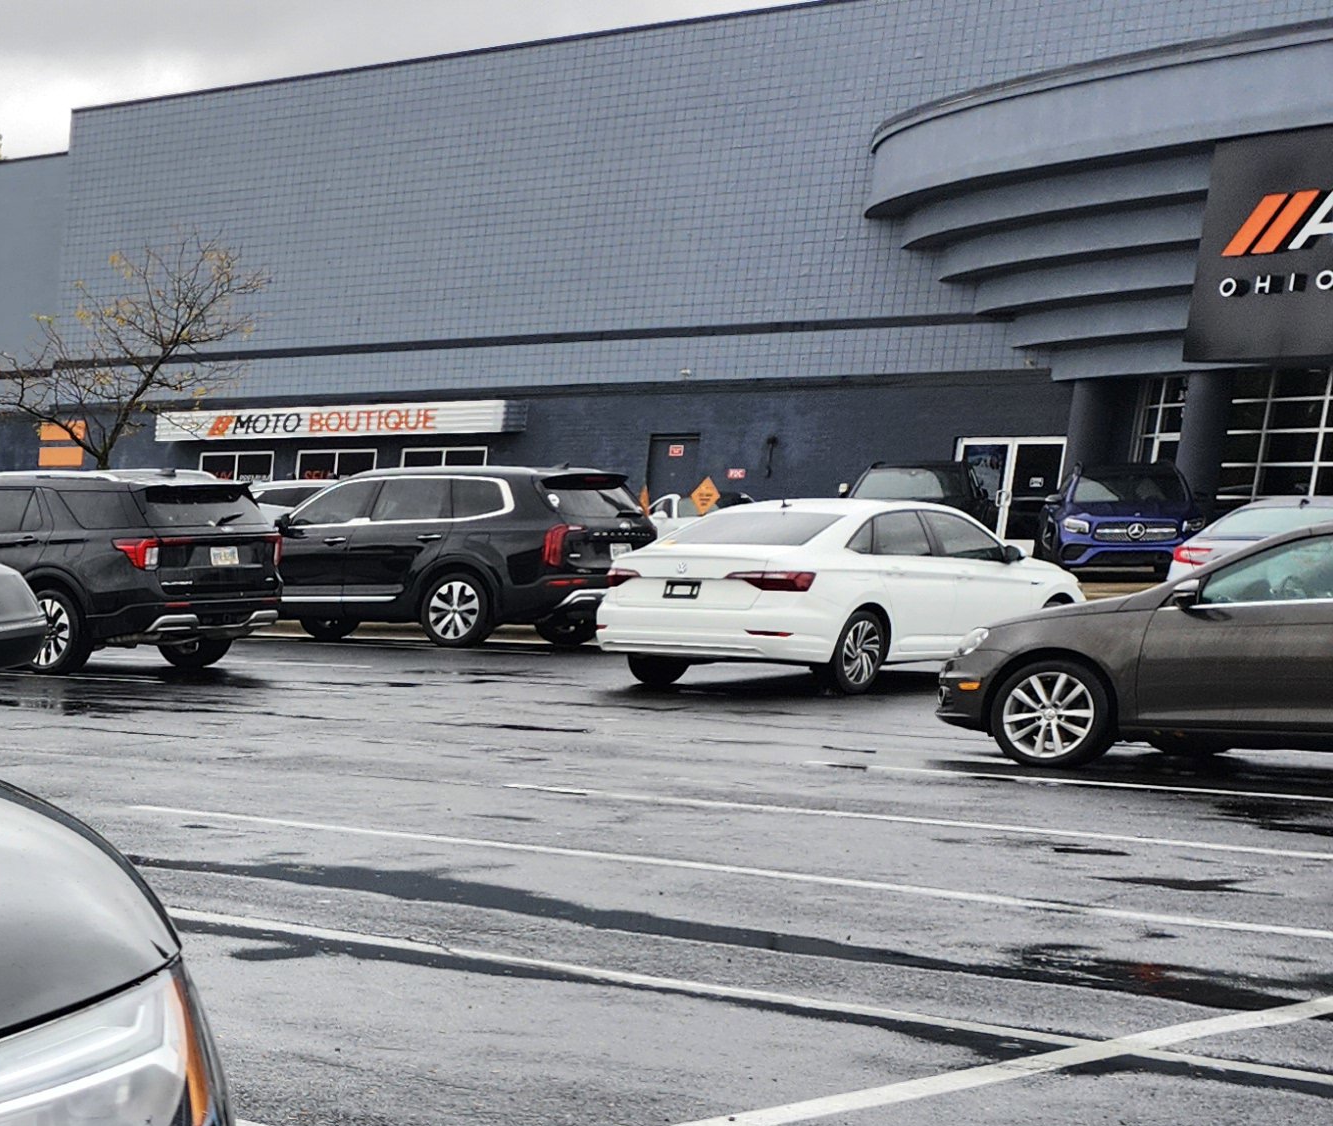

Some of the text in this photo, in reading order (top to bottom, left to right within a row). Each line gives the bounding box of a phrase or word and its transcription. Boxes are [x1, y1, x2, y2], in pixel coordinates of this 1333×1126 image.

[1219, 269, 1333, 297] OHIO
[232, 408, 438, 435] MOTO BOUTIQUE
